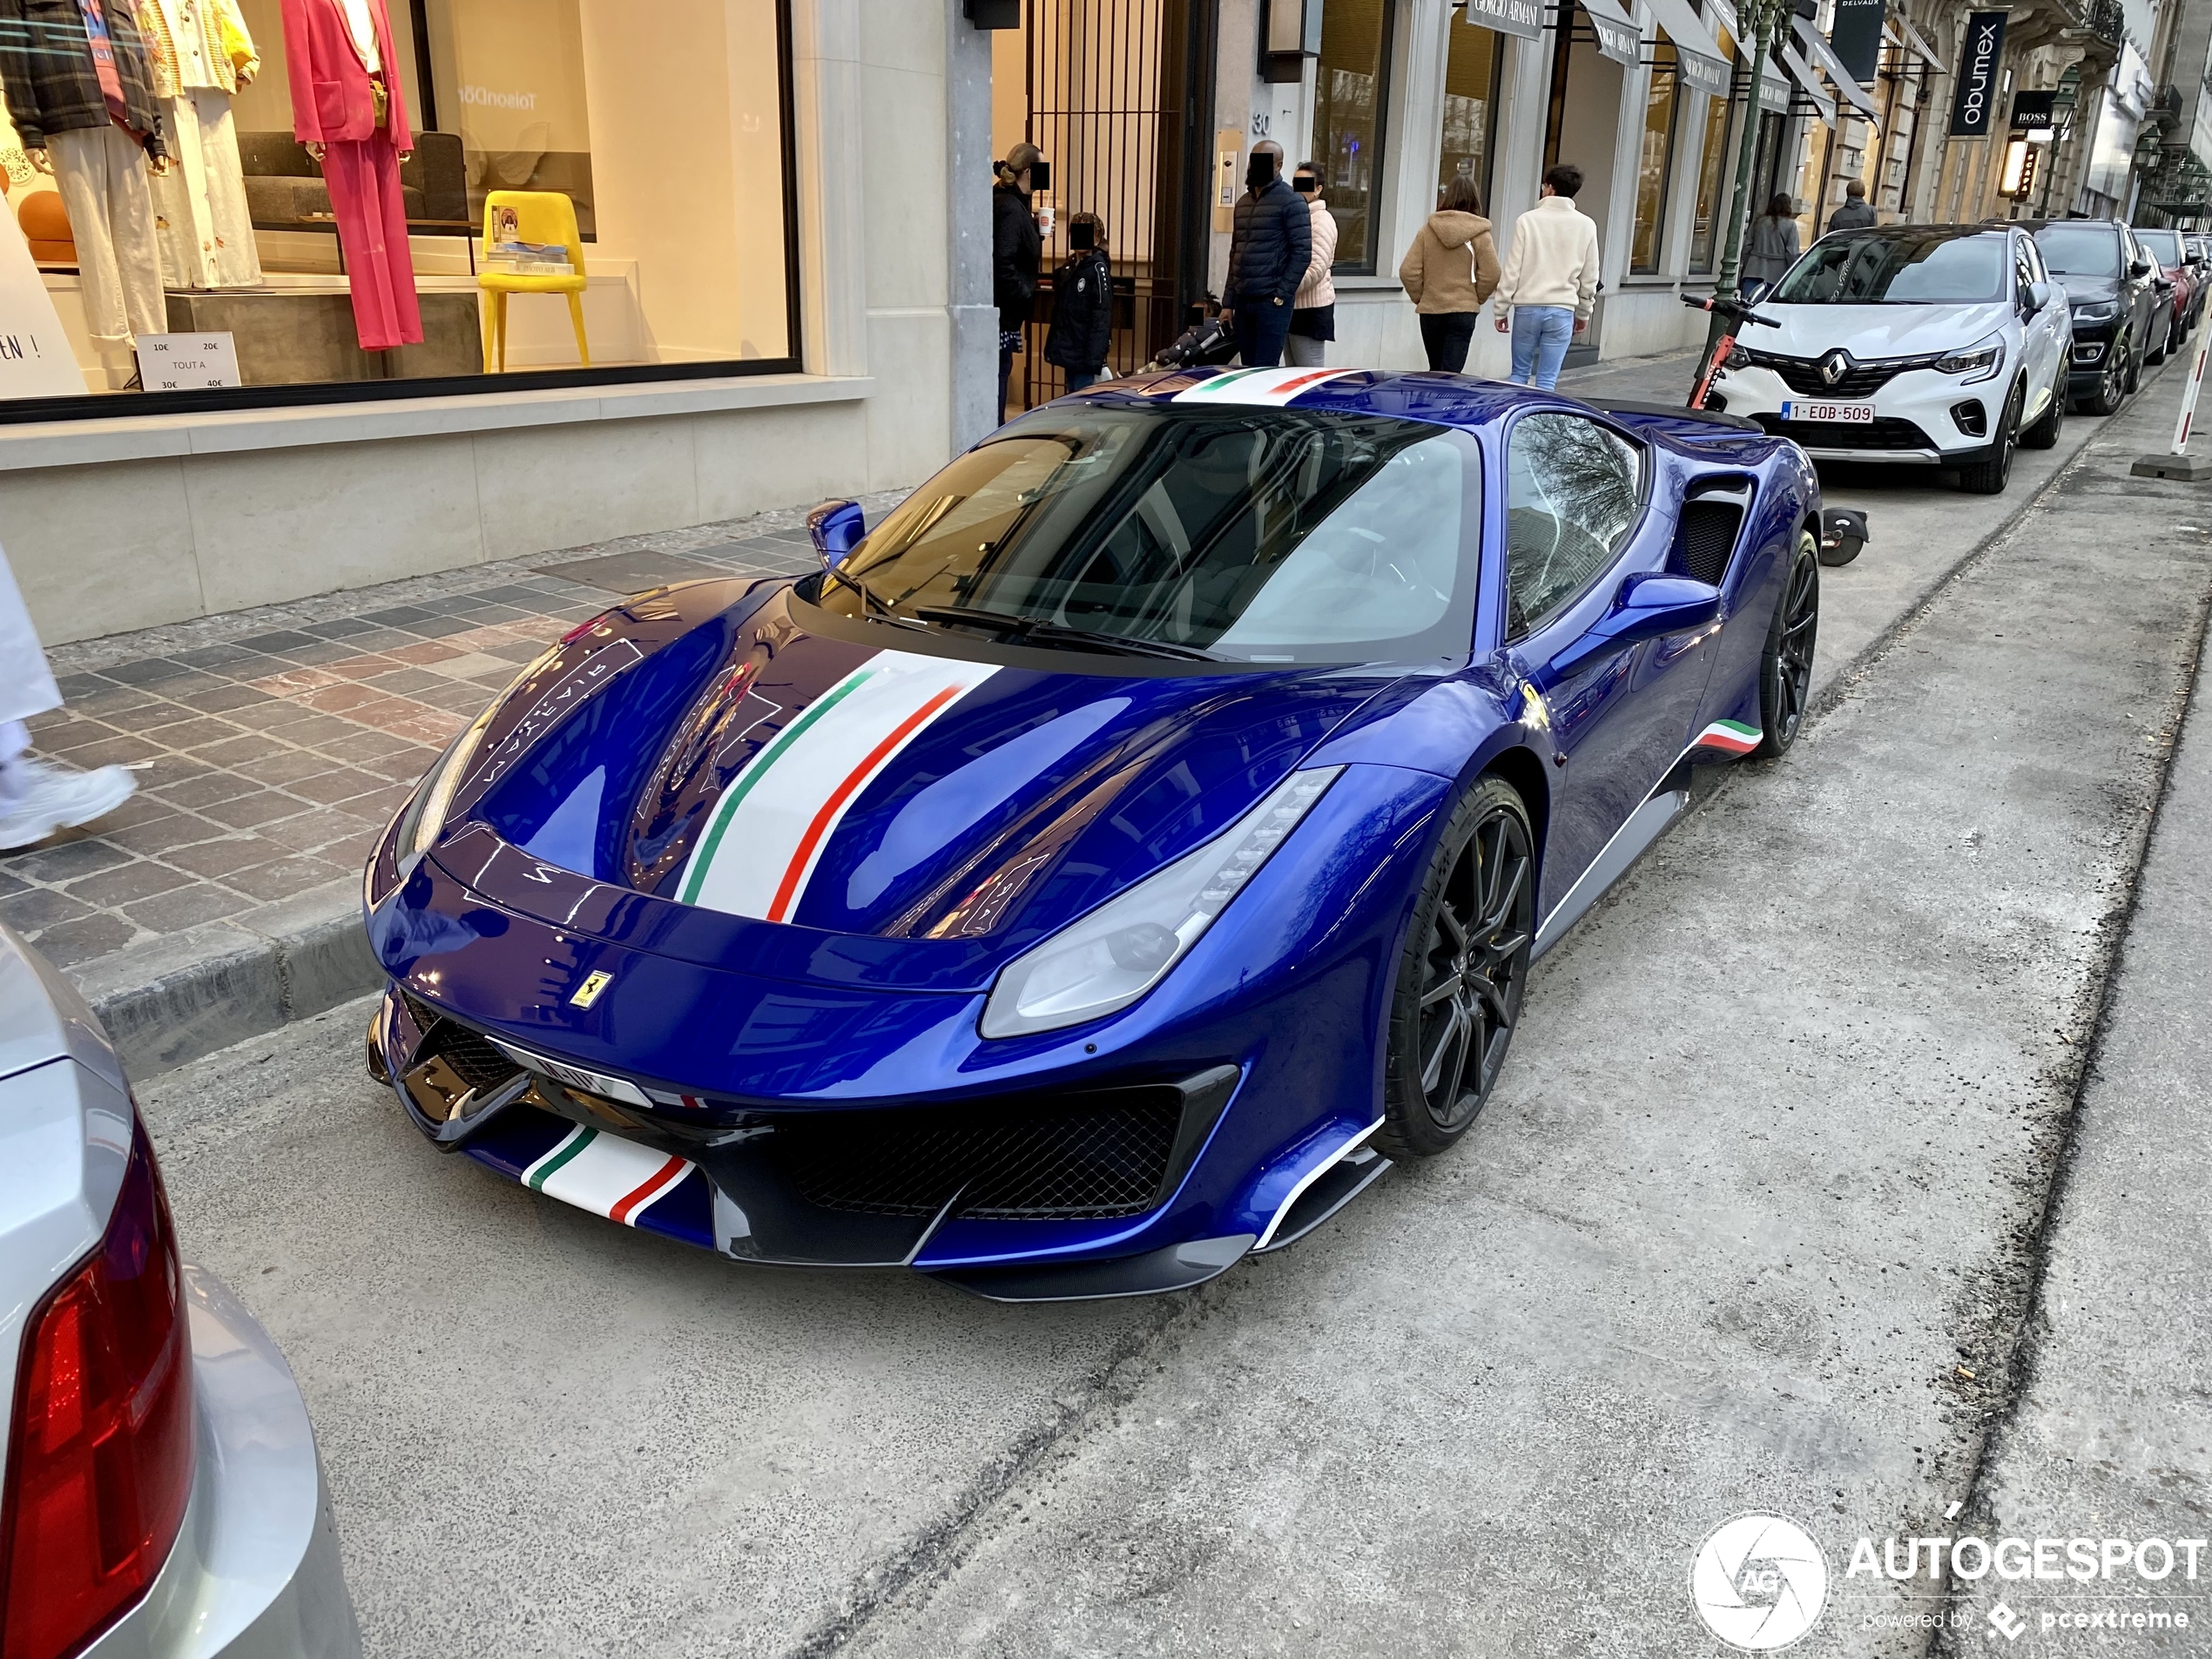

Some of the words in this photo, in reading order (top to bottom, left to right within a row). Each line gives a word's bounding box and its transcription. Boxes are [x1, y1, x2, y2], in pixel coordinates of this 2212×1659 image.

[1507, 1, 1538, 26] ARMANI
[1964, 24, 1997, 124] obumex
[1252, 113, 1271, 135] 30
[2019, 112, 2047, 121] BOSS
[0, 334, 23, 360] EN
[172, 361, 197, 369] TOUT
[162, 381, 179, 389] 30€
[207, 379, 223, 388] 40€
[1794, 405, 1871, 421] 1-EOB-509
